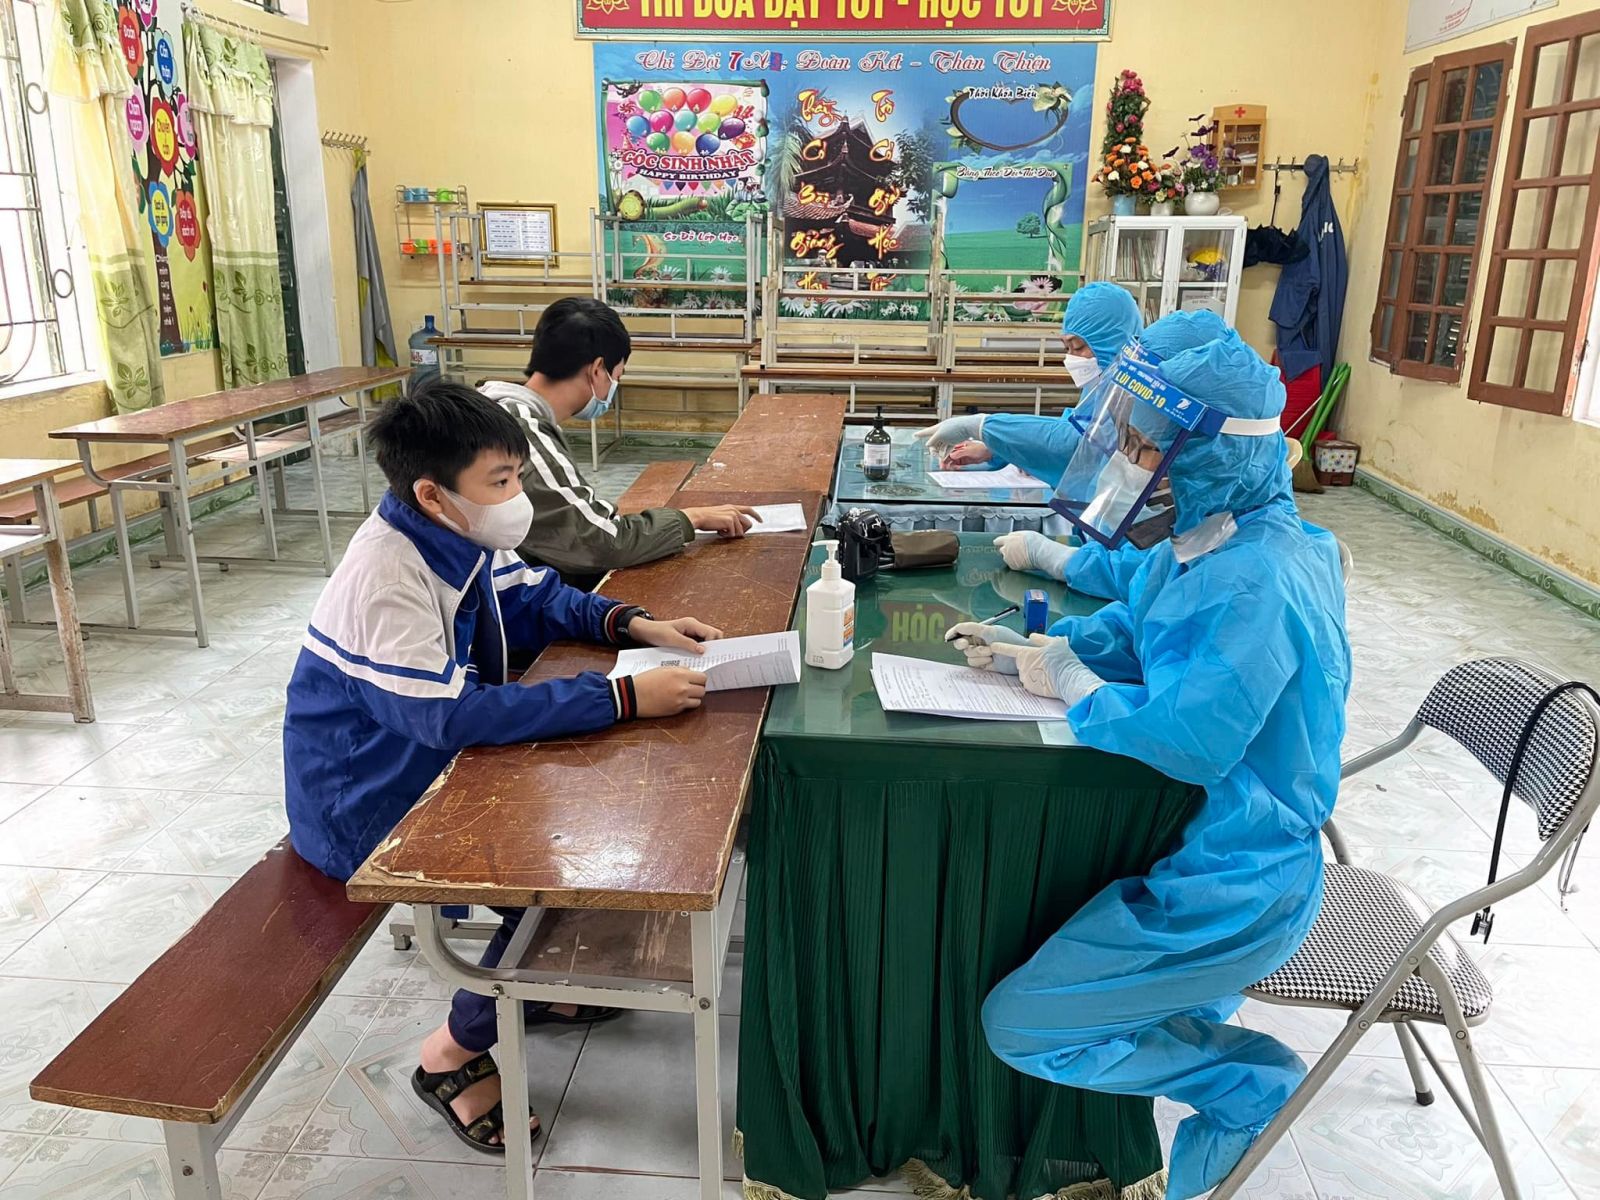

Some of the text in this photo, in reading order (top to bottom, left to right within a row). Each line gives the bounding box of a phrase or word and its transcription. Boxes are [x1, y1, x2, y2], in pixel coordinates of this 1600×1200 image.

[635, 49, 674, 72] Chi
[682, 50, 721, 74] Đội
[796, 50, 850, 72] Đoàn
[929, 50, 985, 73] Thân
[992, 50, 1051, 74] Thiện
[1015, 84, 1037, 99] Biểu
[621, 149, 757, 171] GÓC SINH NHẬT
[639, 168, 738, 181] HAPPY BIRTHDAY
[718, 231, 739, 243] Học
[1127, 378, 1167, 408] COVID-19
